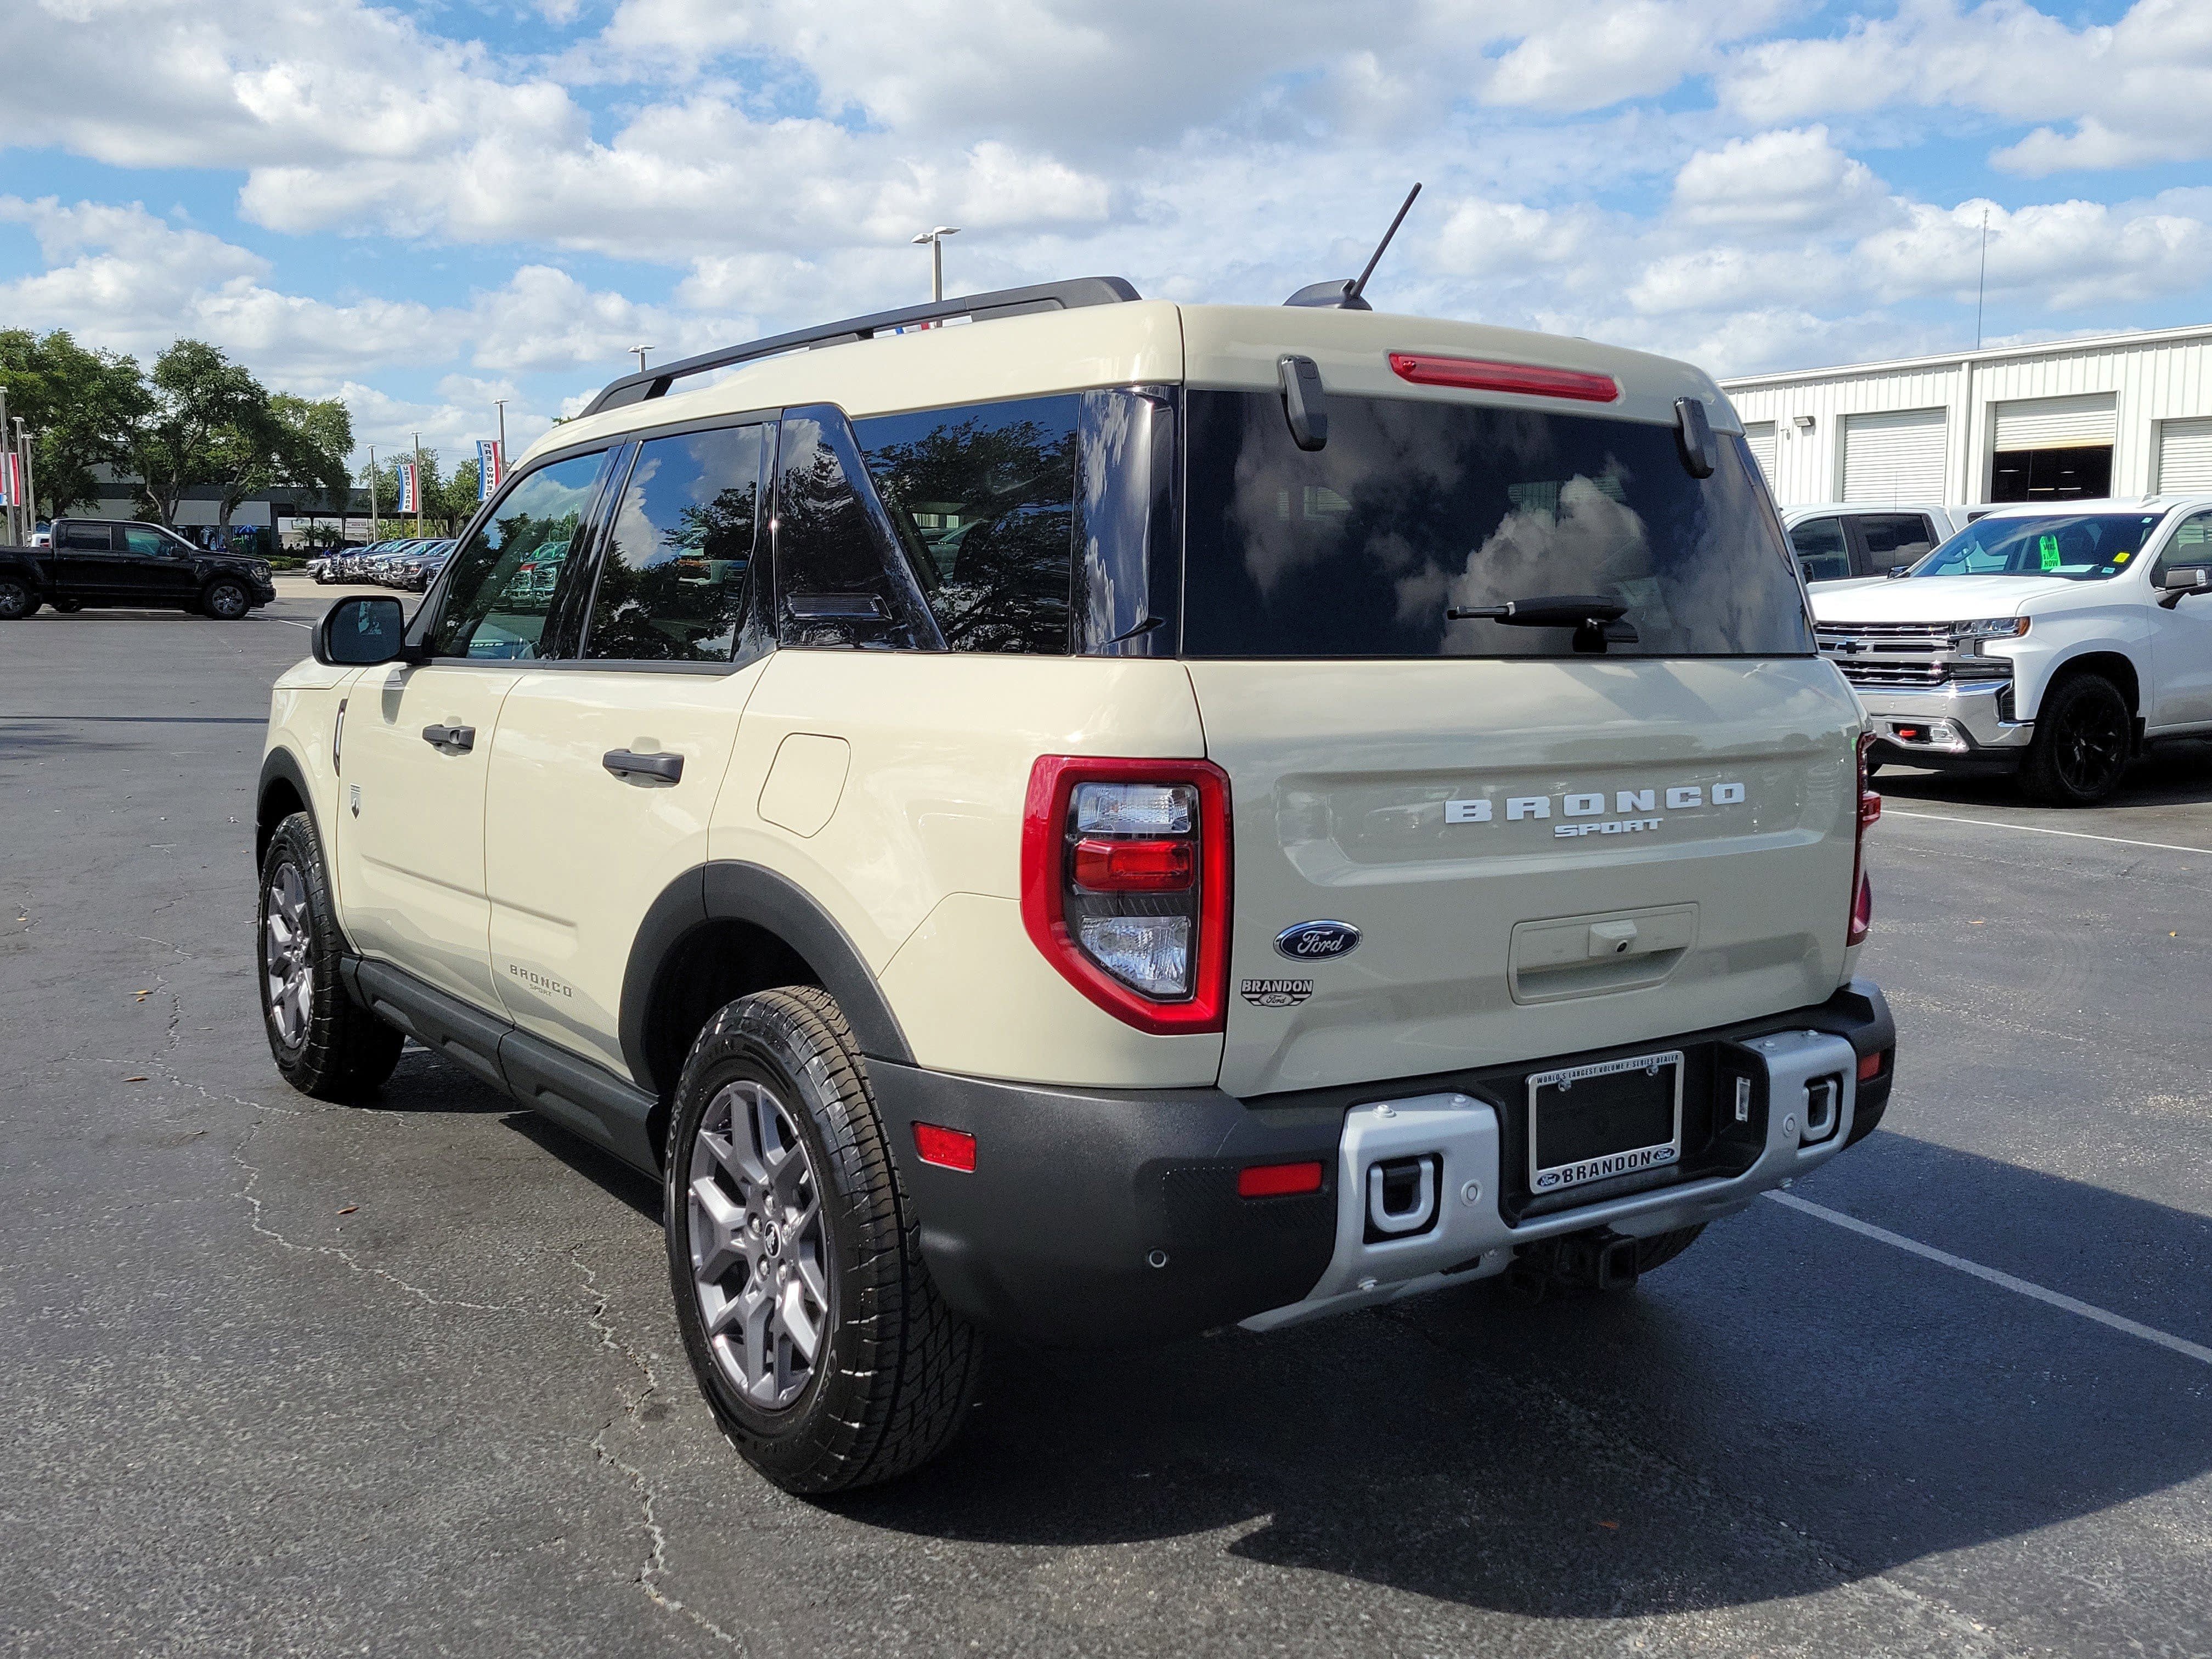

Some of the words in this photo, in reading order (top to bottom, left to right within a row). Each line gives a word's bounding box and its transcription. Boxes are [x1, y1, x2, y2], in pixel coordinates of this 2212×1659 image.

[1445, 783, 1745, 823] BRONCO
[1554, 817, 1663, 838] SPORT
[1297, 930, 1344, 953] Ford
[510, 964, 572, 997] BRONCO
[1242, 980, 1313, 992] BRANDON
[1266, 994, 1287, 1004] Ford
[1537, 1072, 1566, 1084] WORLD'S
[1568, 1068, 1596, 1078] LARGEST
[1599, 1063, 1624, 1073] VOLUME
[1656, 1054, 1679, 1064] DEALER
[1562, 1151, 1652, 1183] BRANDON
